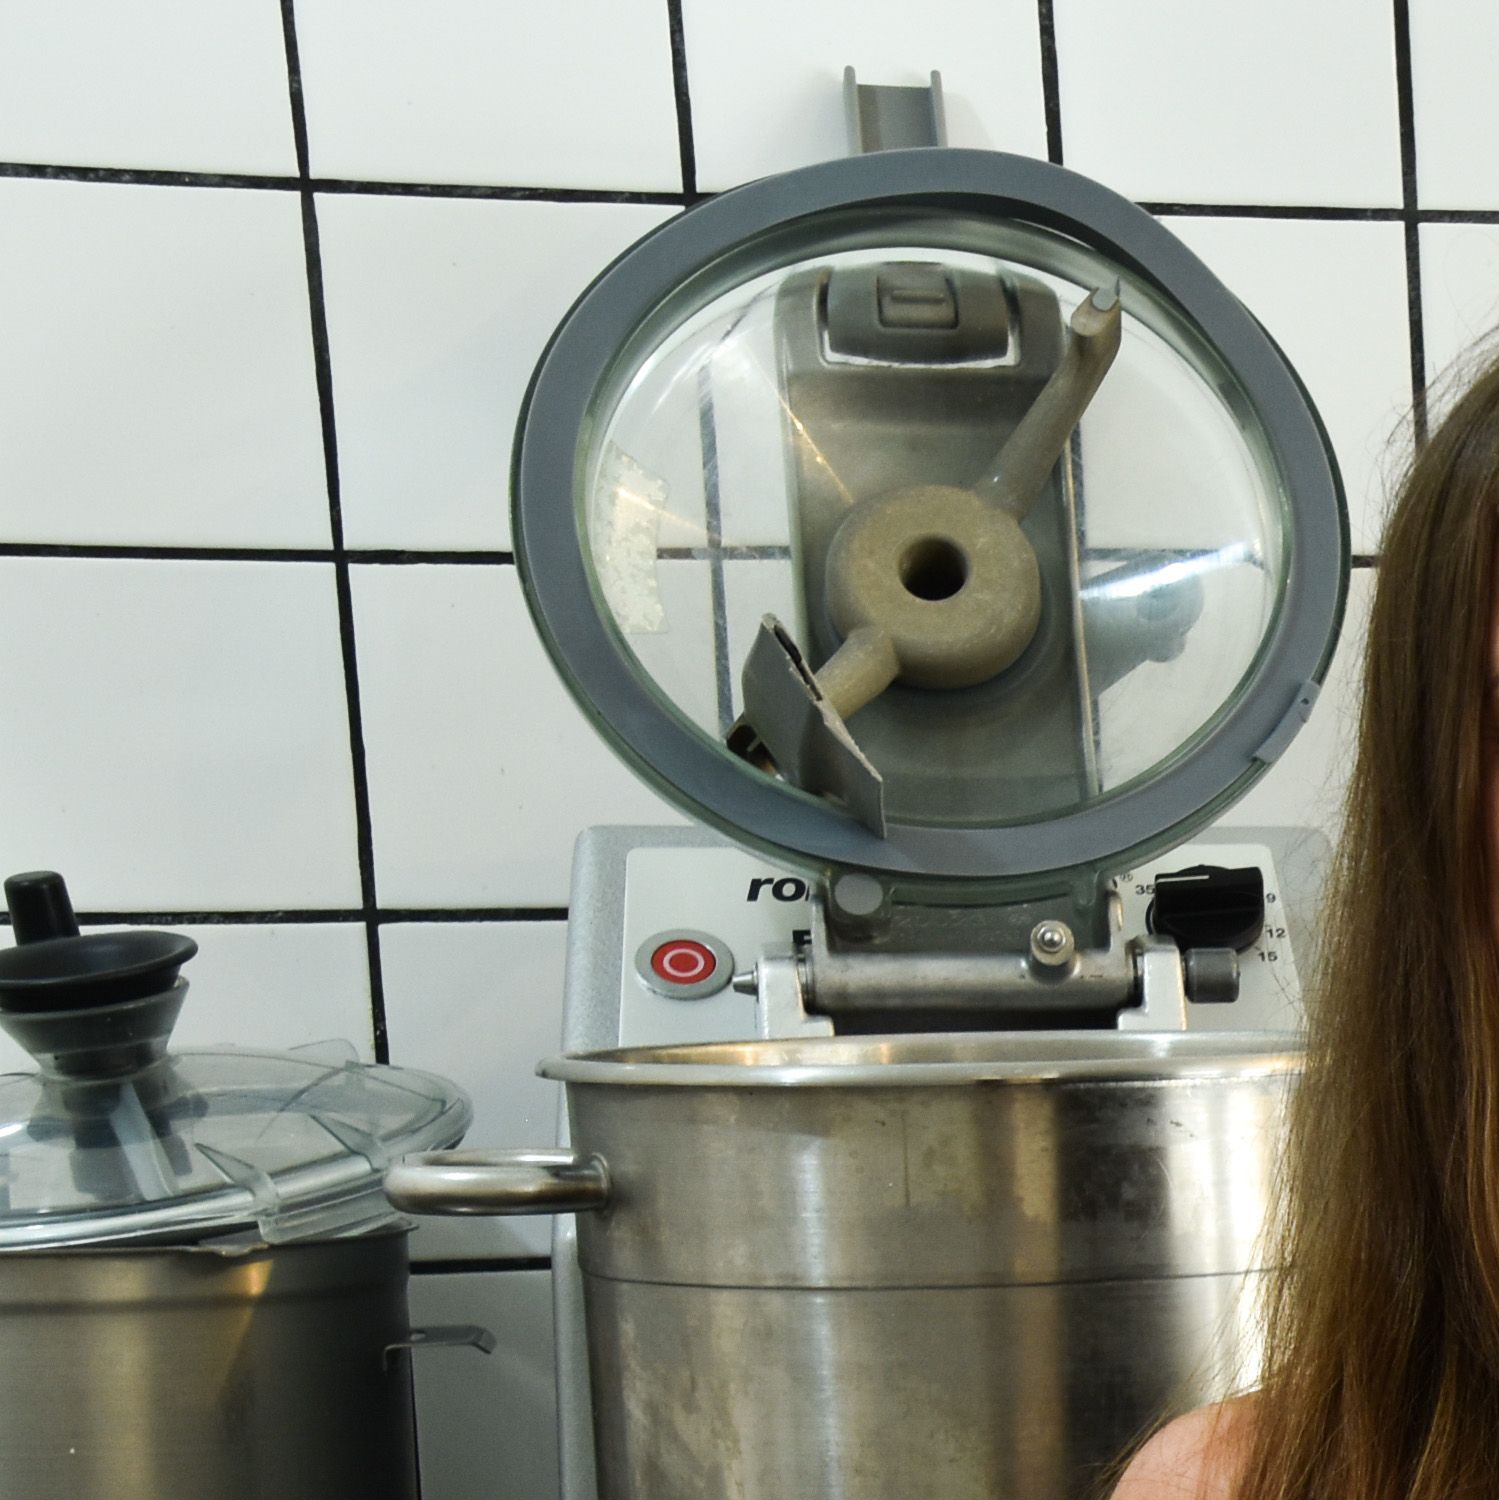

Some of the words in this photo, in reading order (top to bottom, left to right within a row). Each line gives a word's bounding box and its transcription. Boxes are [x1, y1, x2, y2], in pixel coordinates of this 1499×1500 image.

[1135, 884, 1156, 895] 35
[1267, 928, 1286, 939] 12
[1258, 951, 1278, 962] 15
